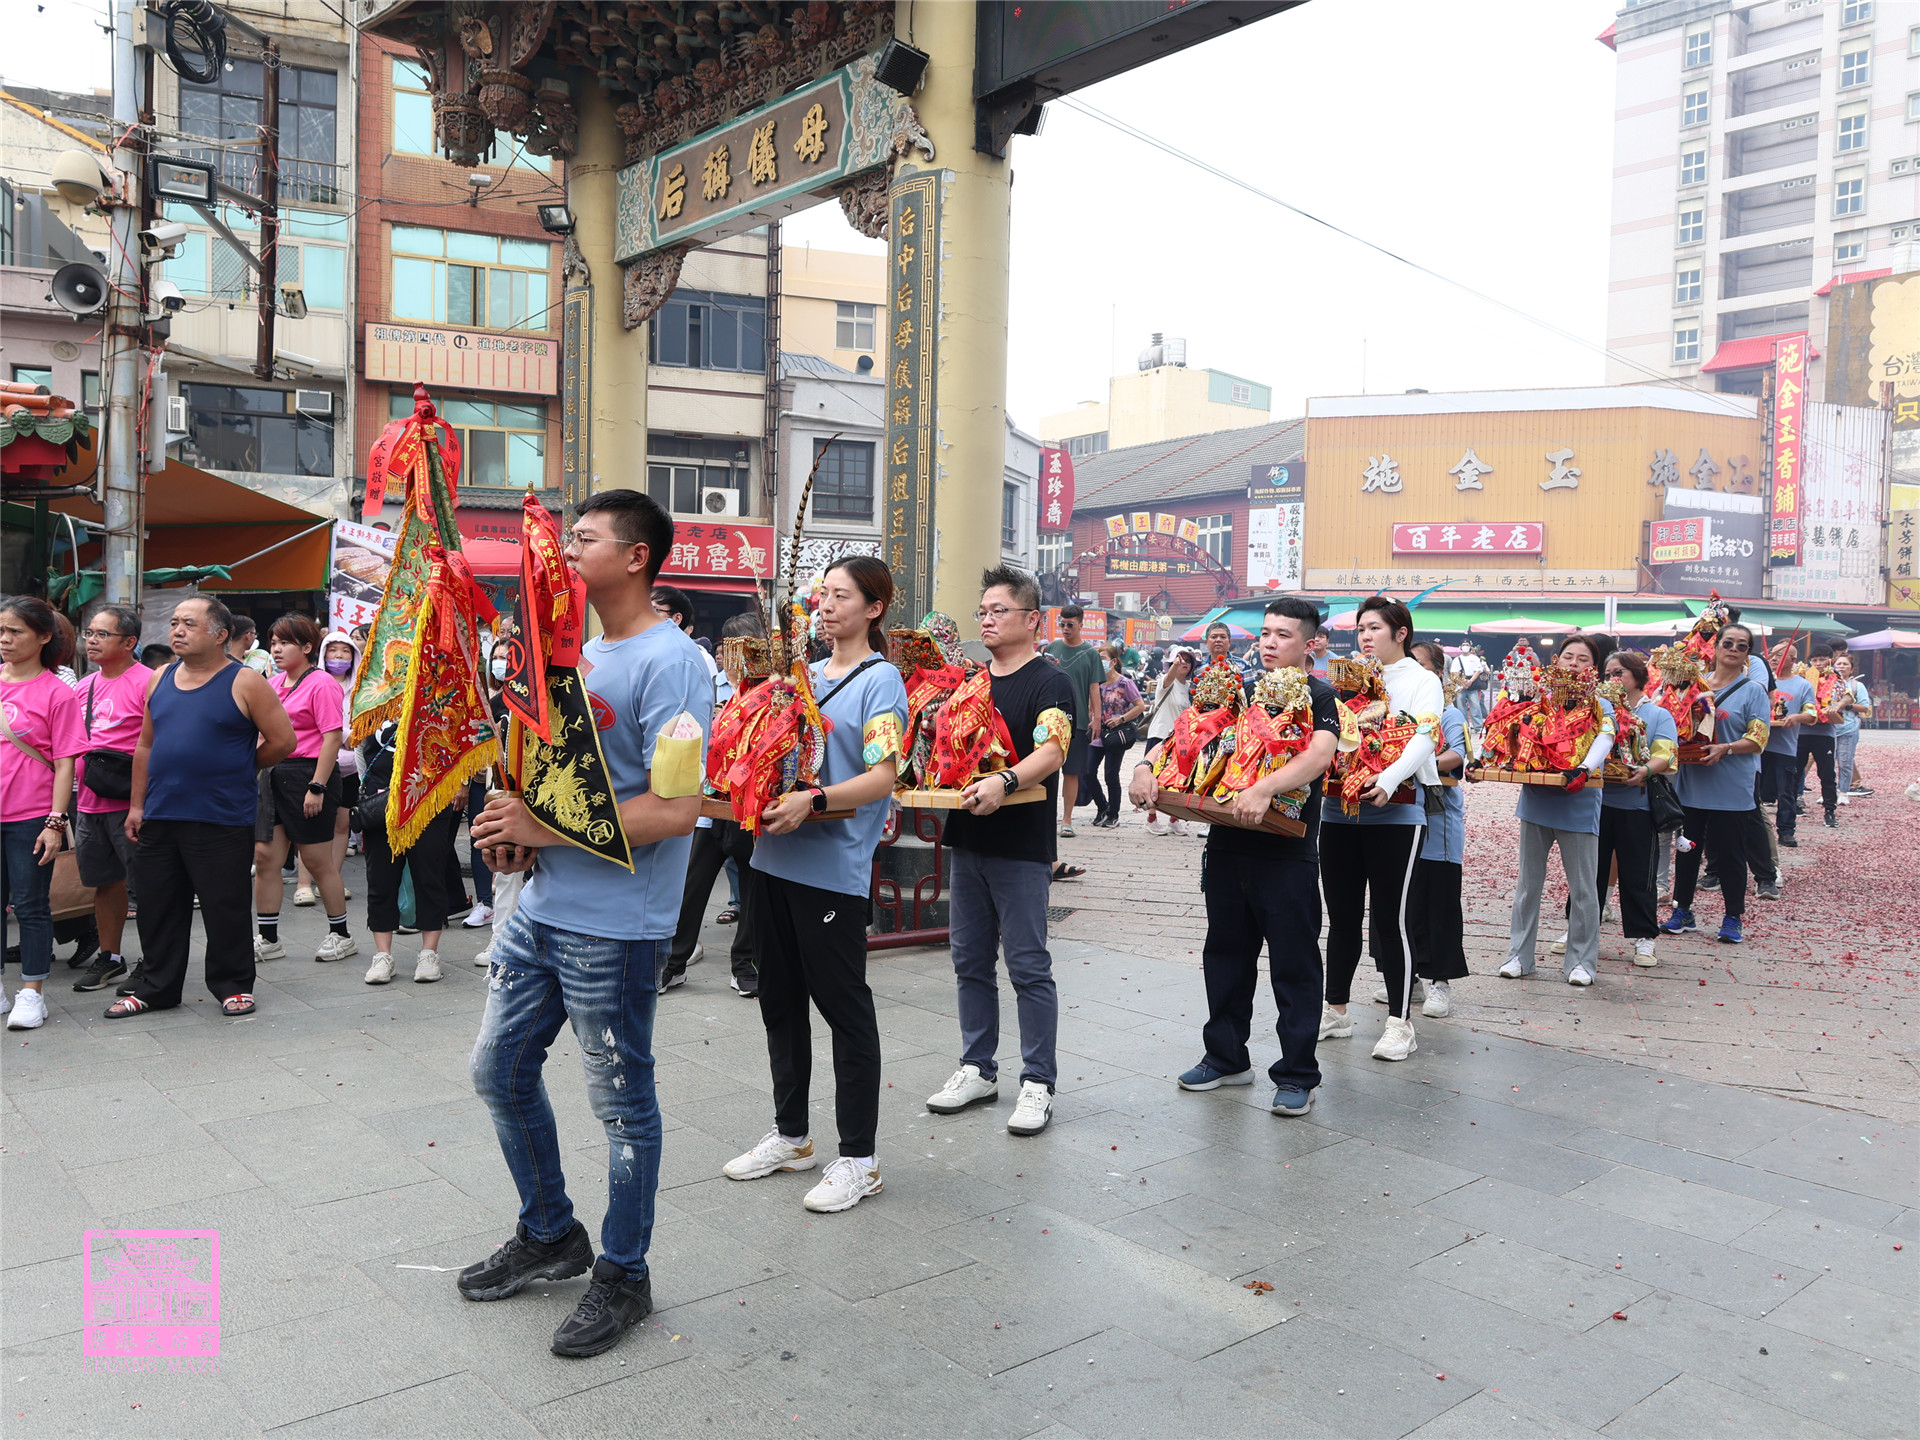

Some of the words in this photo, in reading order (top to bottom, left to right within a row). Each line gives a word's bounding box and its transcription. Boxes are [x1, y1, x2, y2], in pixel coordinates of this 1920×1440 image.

[374, 327, 446, 346] 祖傳第四代
[477, 337, 549, 356] 道地老字號
[1361, 448, 1582, 493] 施金玉
[1046, 452, 1065, 526] 玉珍齋
[1407, 525, 1529, 550] 百年老店
[1771, 532, 1796, 547] 百年老店
[669, 542, 768, 574] 錦魯麵
[865, 747, 877, 761] 01
